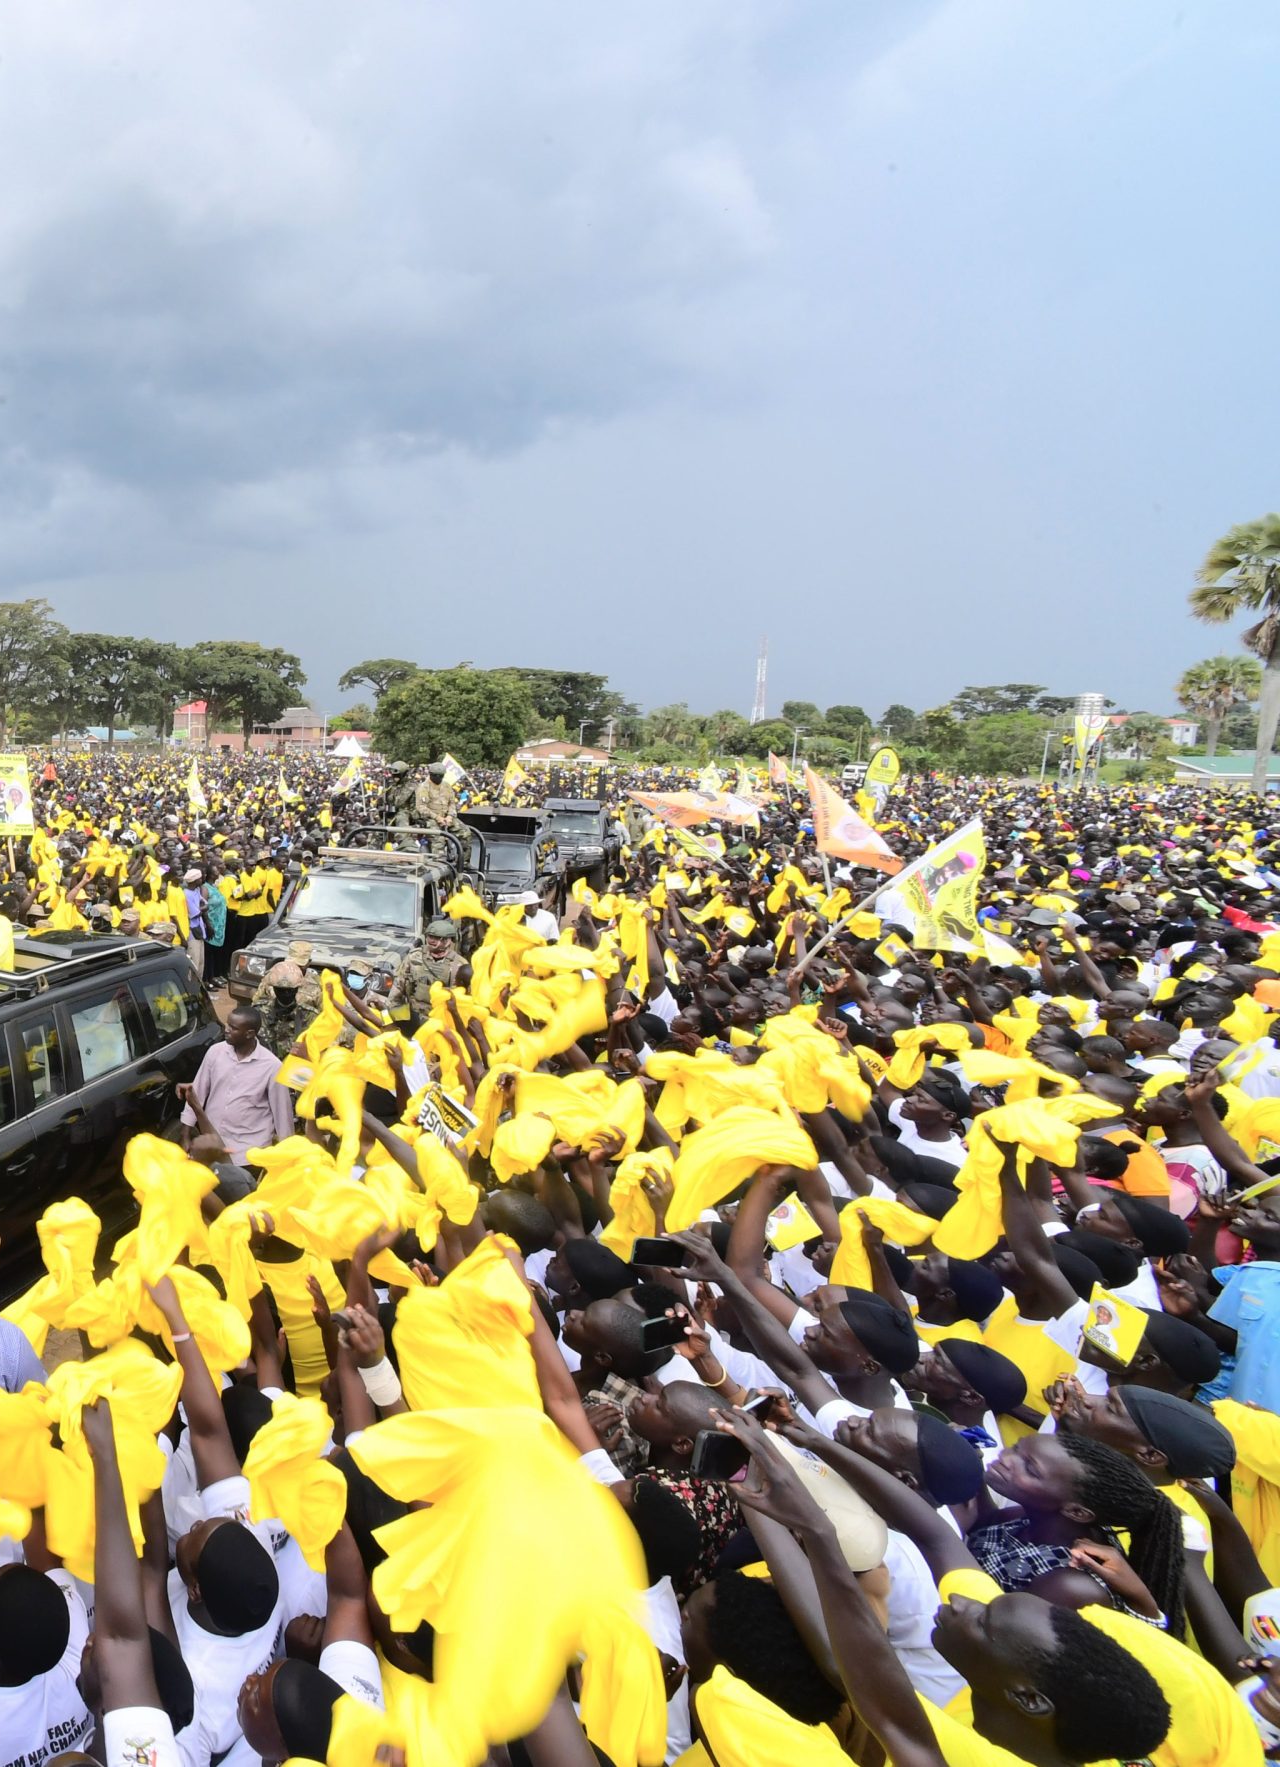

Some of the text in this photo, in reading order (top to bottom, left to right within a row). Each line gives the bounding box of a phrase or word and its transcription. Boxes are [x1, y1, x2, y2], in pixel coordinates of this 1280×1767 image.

[963, 898, 973, 917] THE
[865, 1057, 884, 1073] NRM
[47, 1716, 77, 1740] FACE
